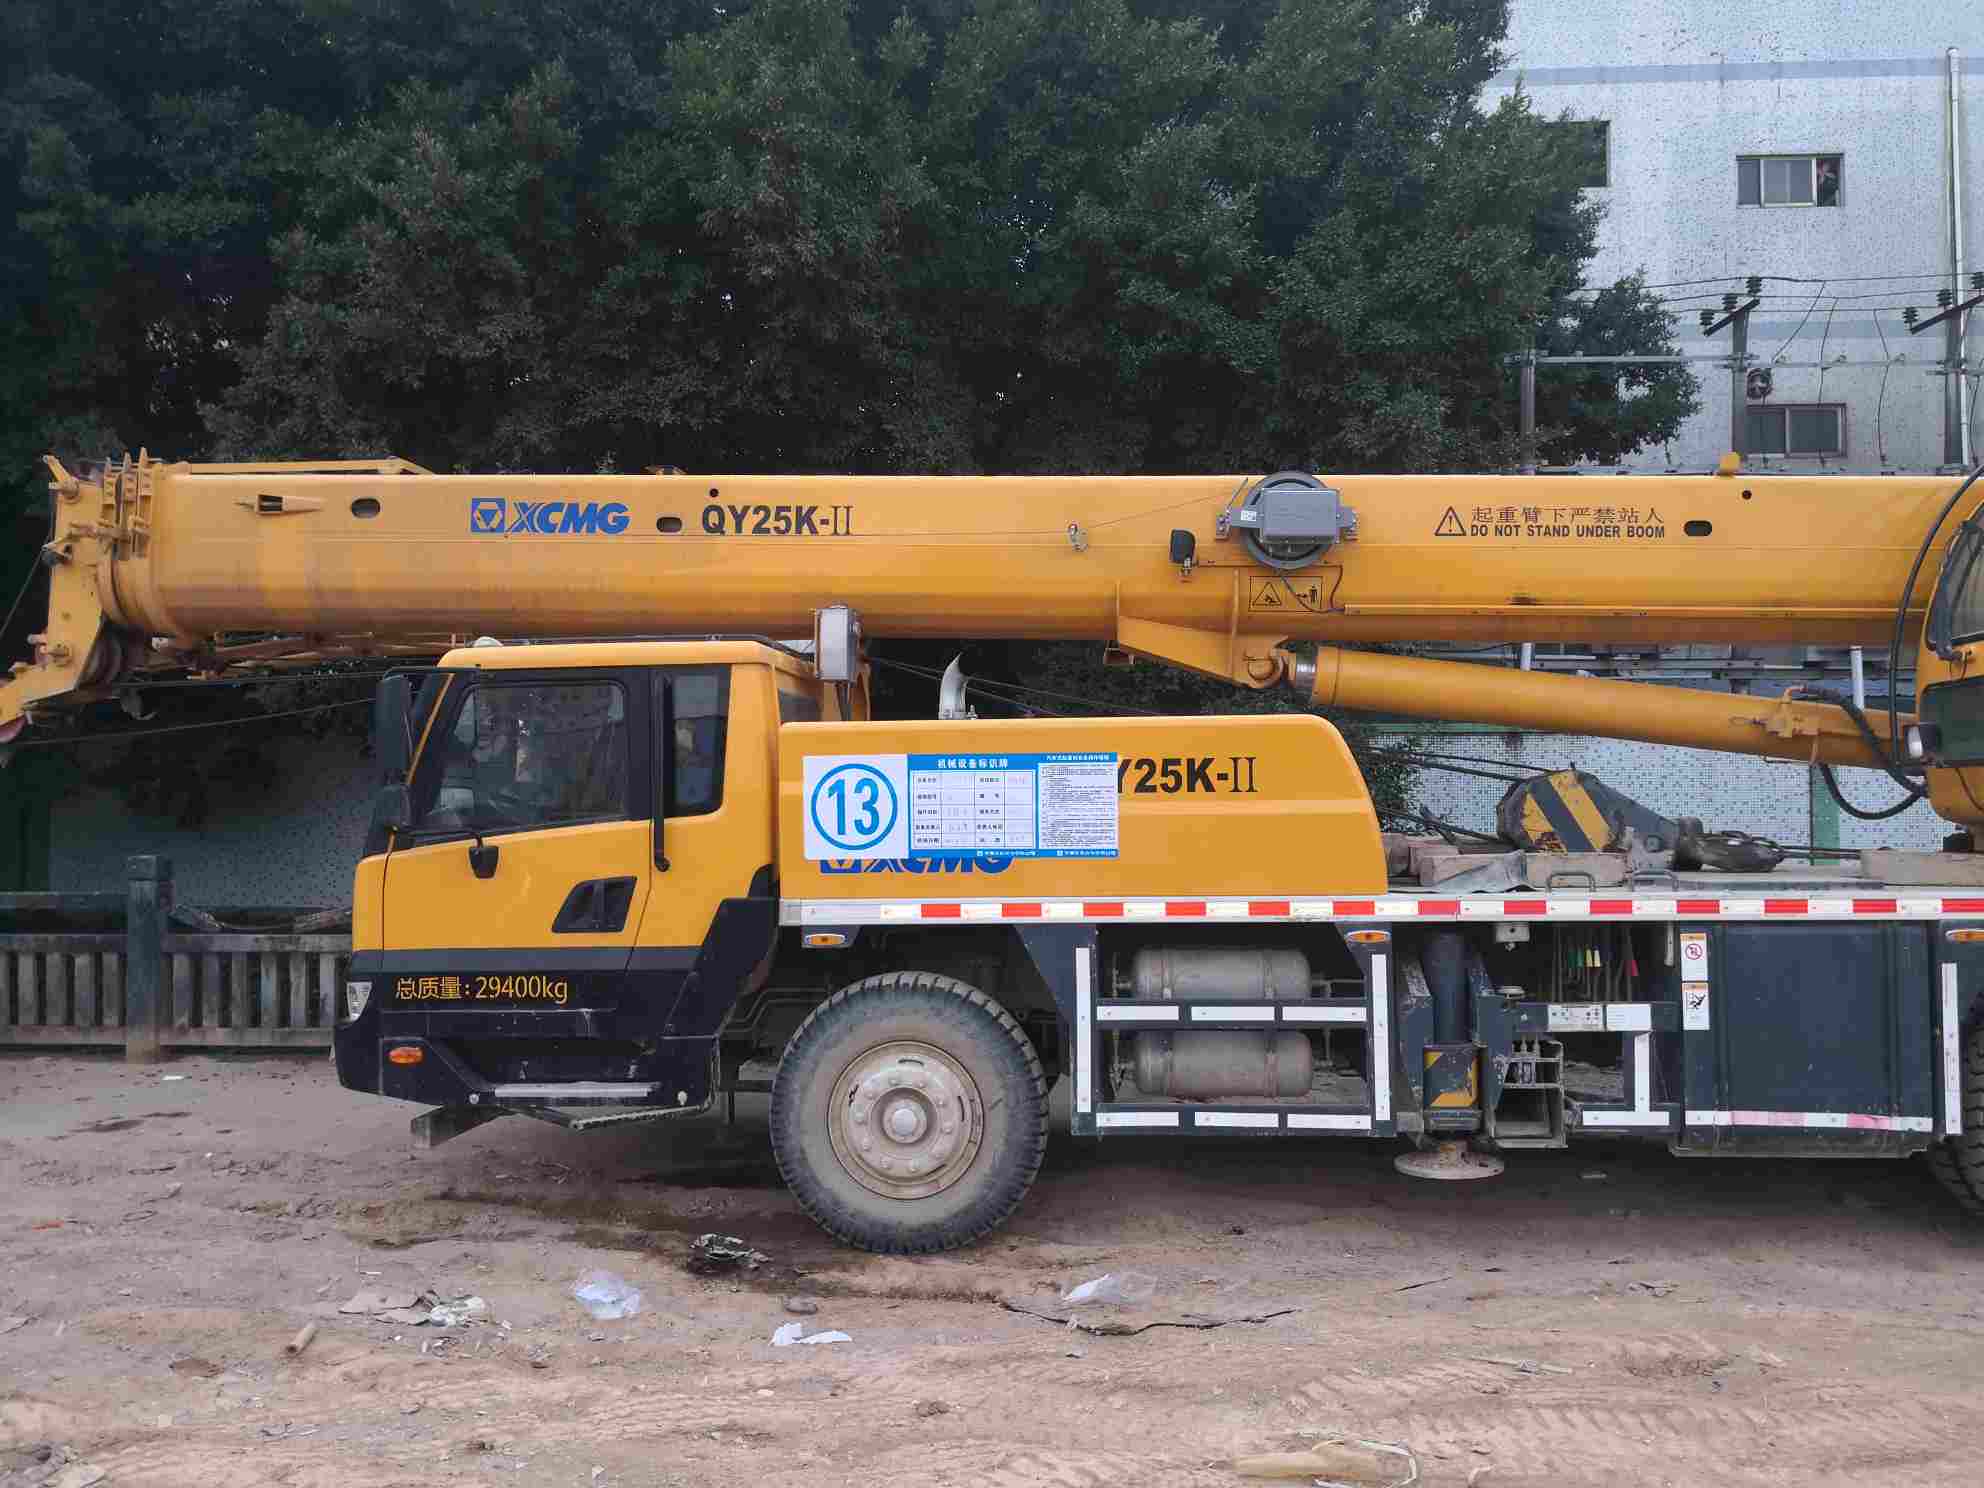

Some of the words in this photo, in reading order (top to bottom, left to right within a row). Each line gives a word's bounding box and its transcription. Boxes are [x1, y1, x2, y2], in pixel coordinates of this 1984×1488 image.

[508, 502, 631, 535] XCMG
[1471, 506, 1665, 525] 起重臂下严禁站人
[1470, 524, 1489, 538] DO
[1494, 524, 1521, 538] NOT
[1527, 524, 1571, 538] STAND
[1576, 524, 1621, 538] UNDER
[1626, 524, 1665, 538] BOOM
[827, 777, 881, 837] 13
